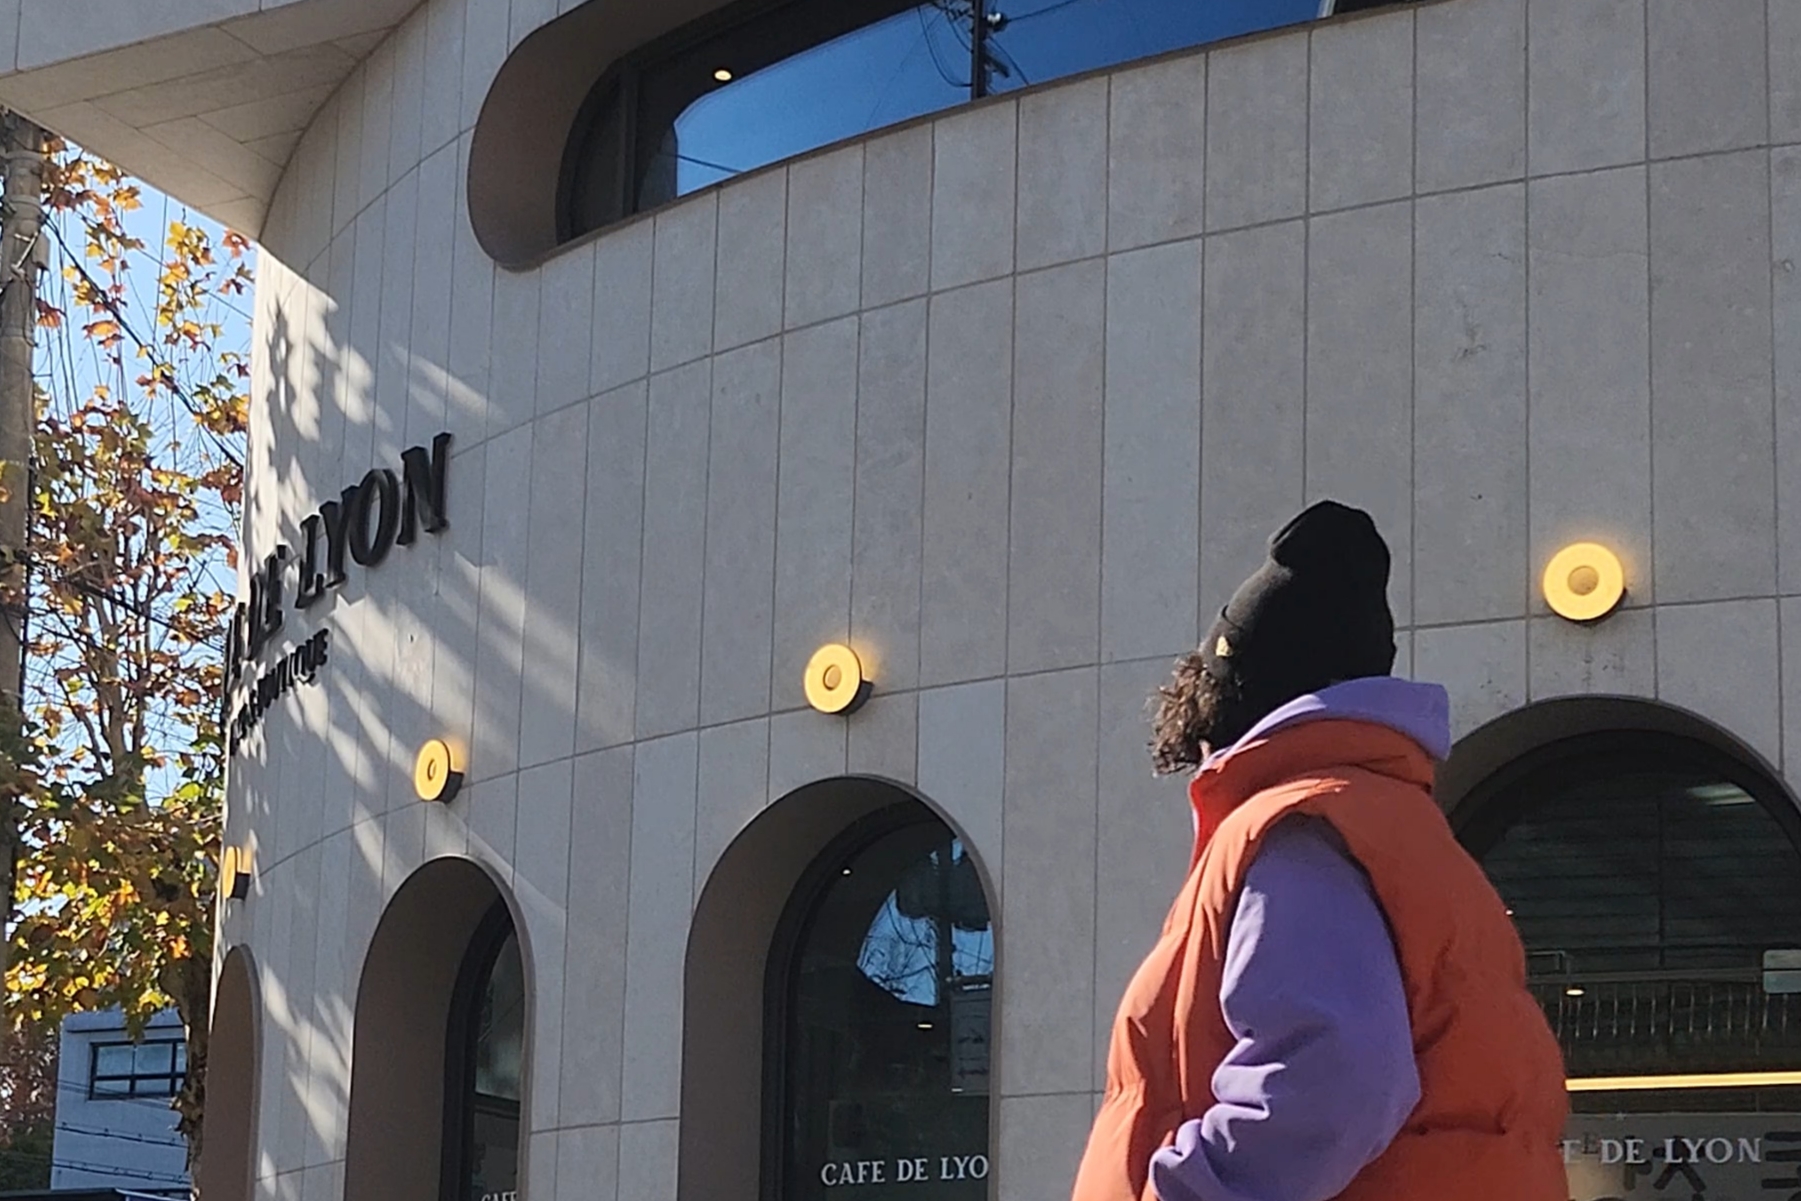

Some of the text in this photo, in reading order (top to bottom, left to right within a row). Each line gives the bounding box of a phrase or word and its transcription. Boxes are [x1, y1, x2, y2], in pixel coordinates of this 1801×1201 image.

[295, 432, 452, 609] LYON
[1600, 1138, 1647, 1164] DE
[1663, 1137, 1762, 1164] LYON
[820, 1160, 886, 1186] CAFE
[896, 1157, 929, 1182] DE
